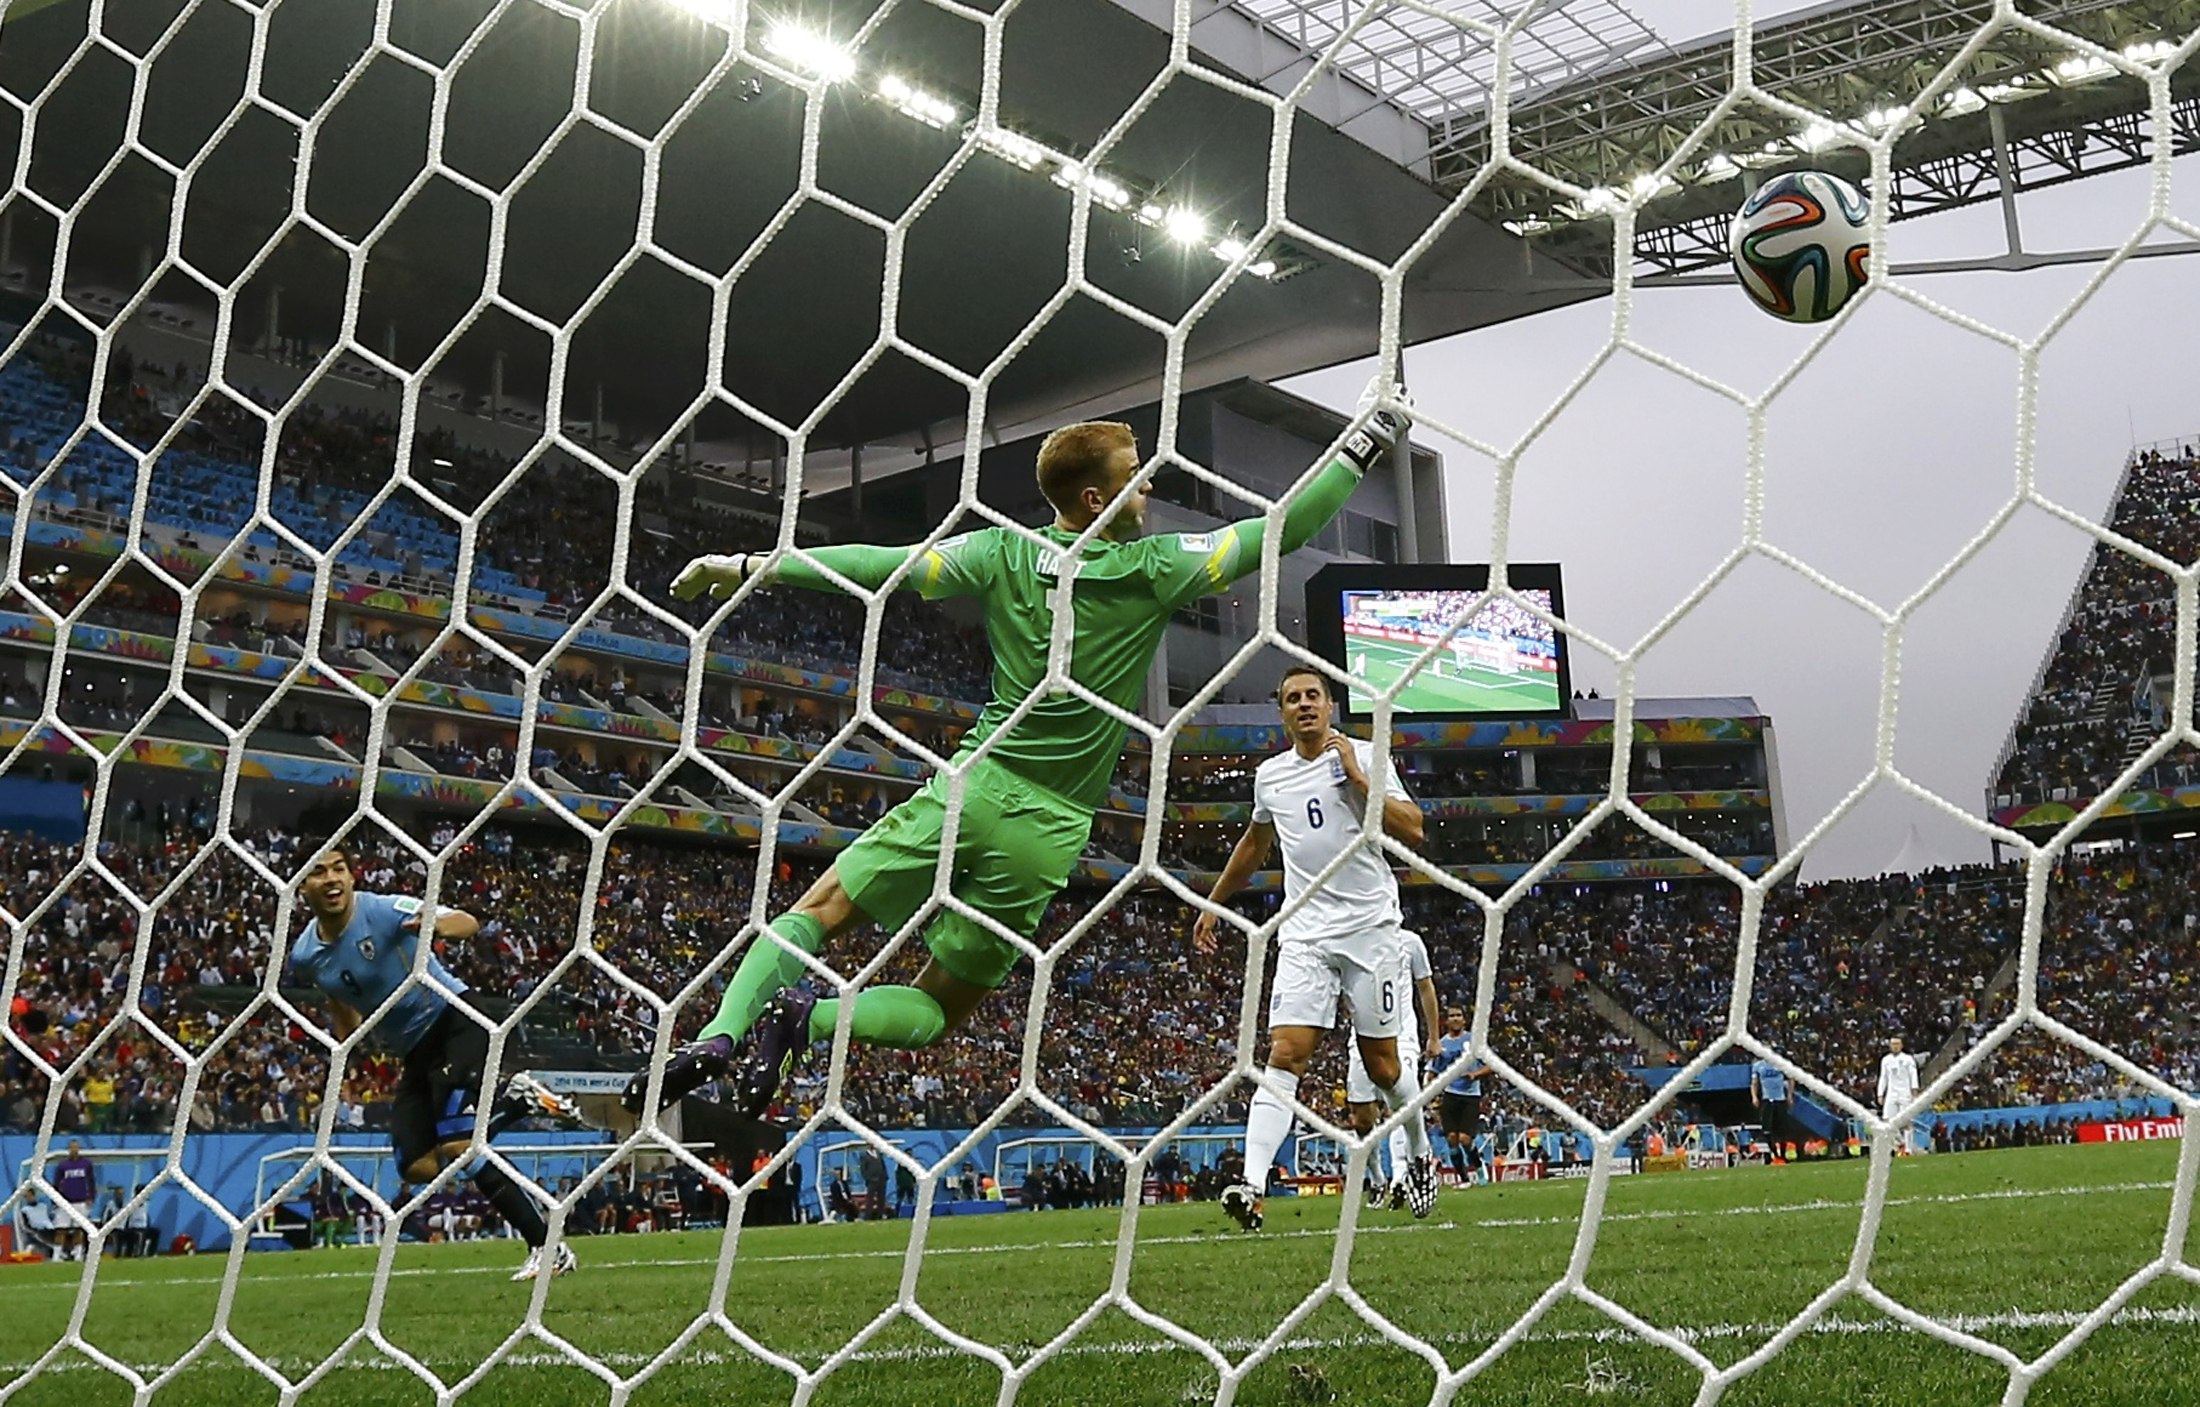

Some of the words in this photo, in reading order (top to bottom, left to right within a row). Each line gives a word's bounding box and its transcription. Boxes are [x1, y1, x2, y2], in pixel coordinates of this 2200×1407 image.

[1036, 549, 1087, 578] HAT
[1307, 798, 1324, 829] 6
[341, 969, 362, 996] 9
[1383, 980, 1393, 1013] 6
[2104, 1123, 2139, 1142] Fly
